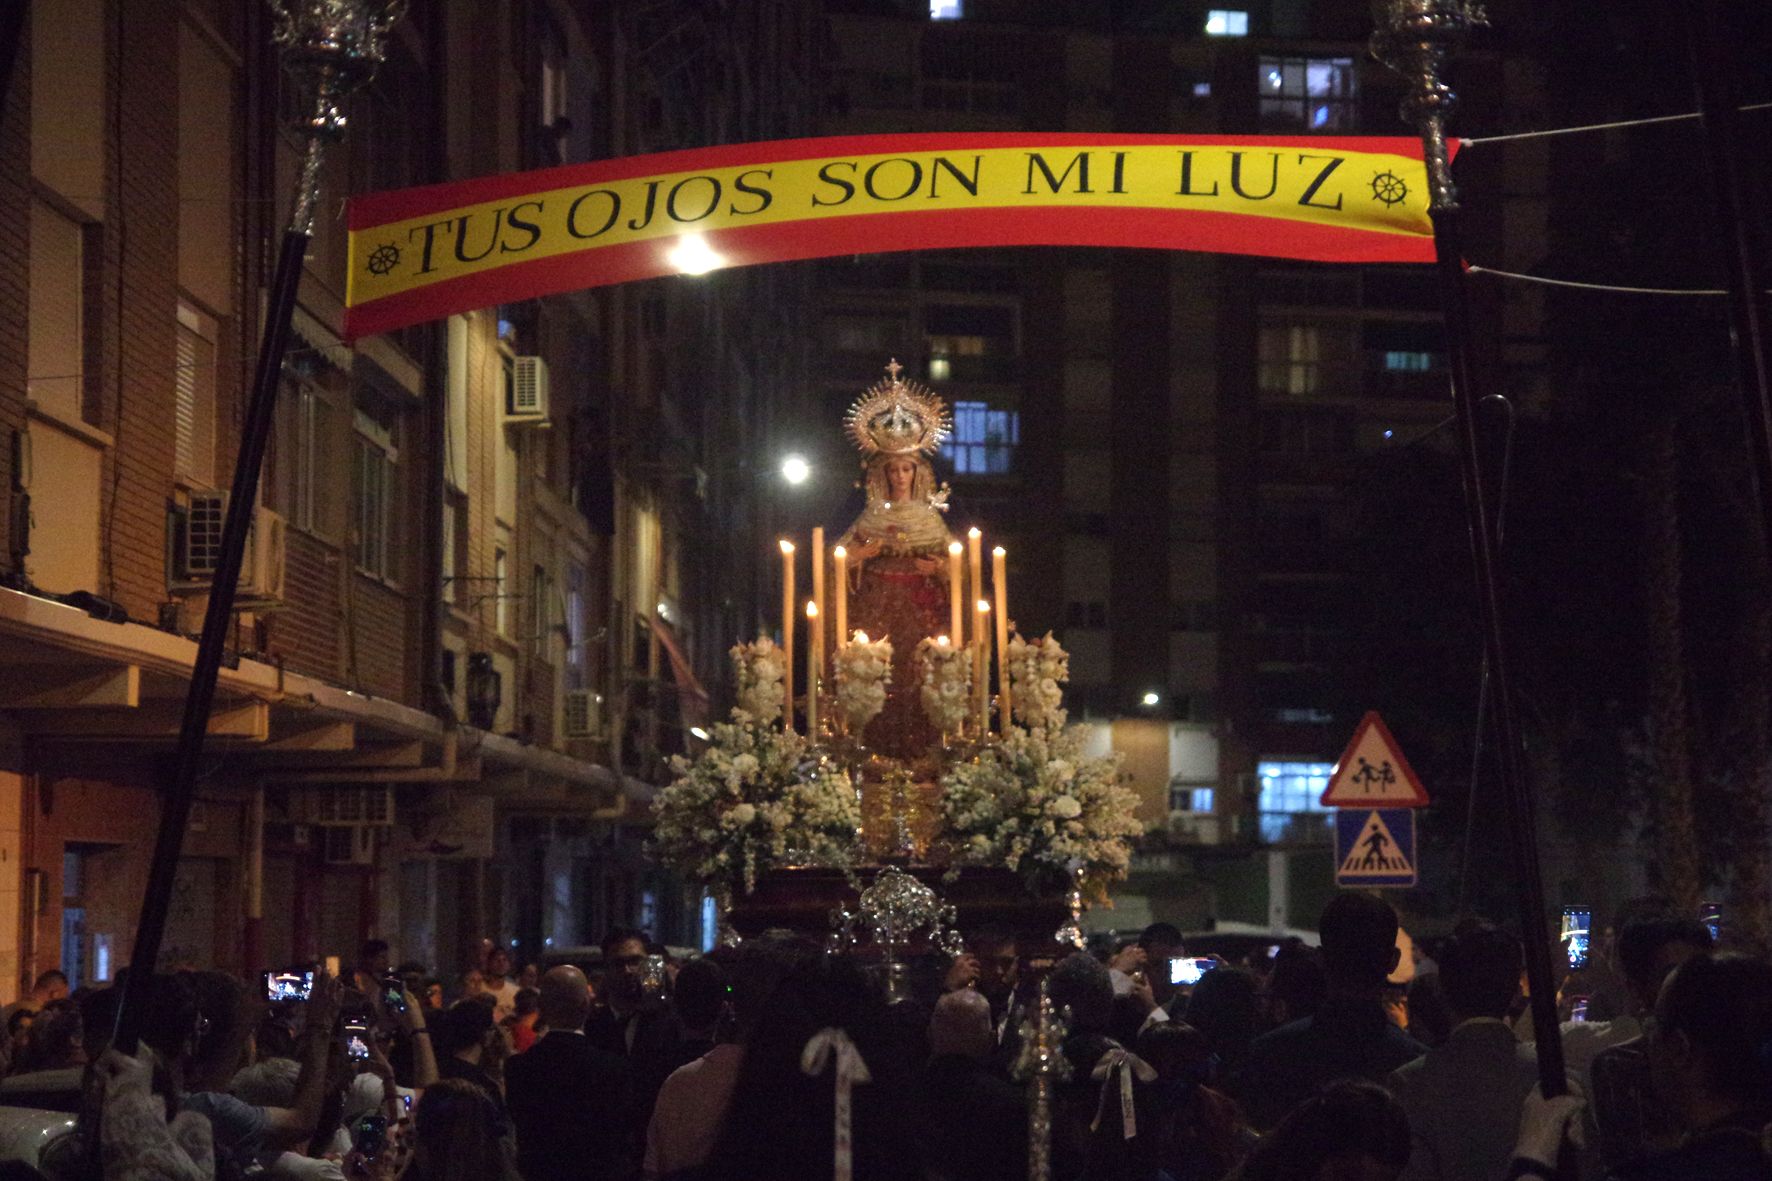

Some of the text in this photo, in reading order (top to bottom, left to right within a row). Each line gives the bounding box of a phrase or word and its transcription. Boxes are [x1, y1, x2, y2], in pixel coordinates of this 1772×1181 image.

[409, 150, 1345, 276] TUS OJOS SON MI LUZ
